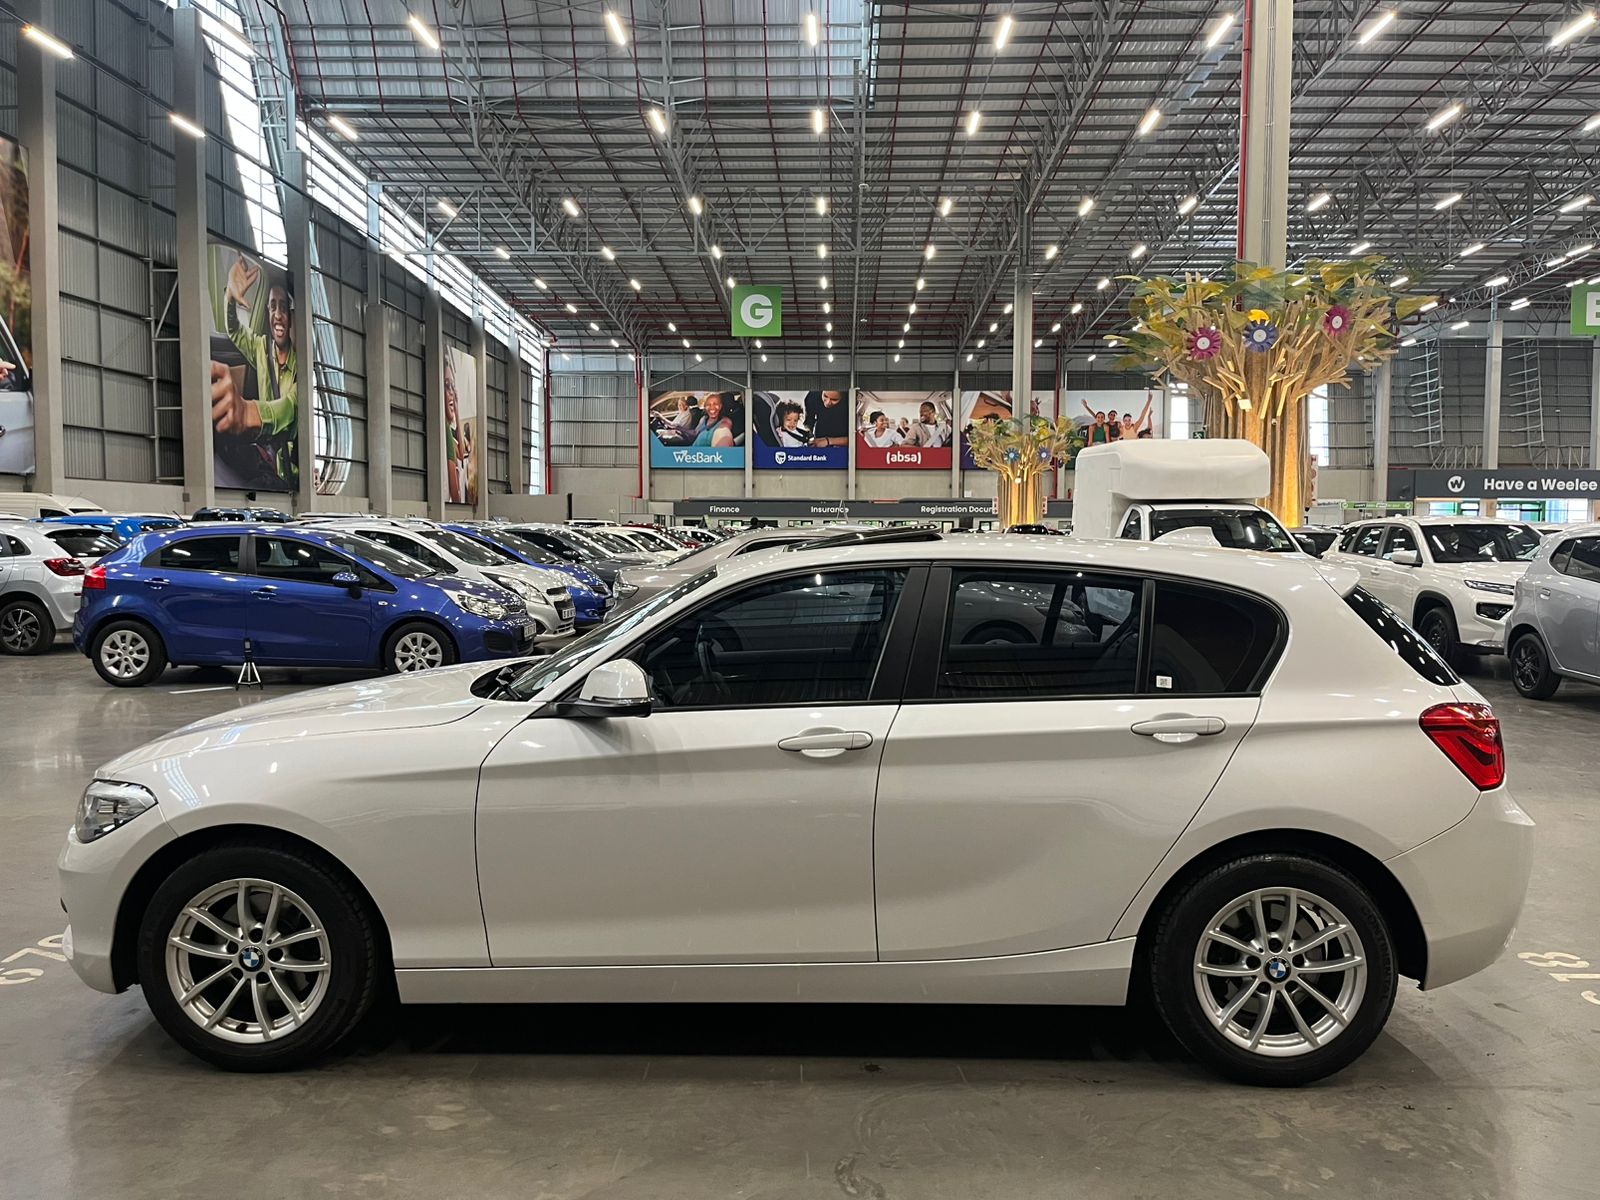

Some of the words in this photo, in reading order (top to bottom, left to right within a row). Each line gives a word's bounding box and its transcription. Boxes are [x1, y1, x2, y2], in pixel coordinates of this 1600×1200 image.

[740, 293, 773, 329] G
[673, 450, 723, 463] WesBank
[886, 450, 922, 465] (absa)
[1484, 478, 1524, 491] Have
[1527, 480, 1538, 491] a
[1541, 478, 1598, 491] Weelee
[709, 505, 740, 513] Finance
[810, 505, 850, 513] Insurance
[920, 505, 967, 514] Registration
